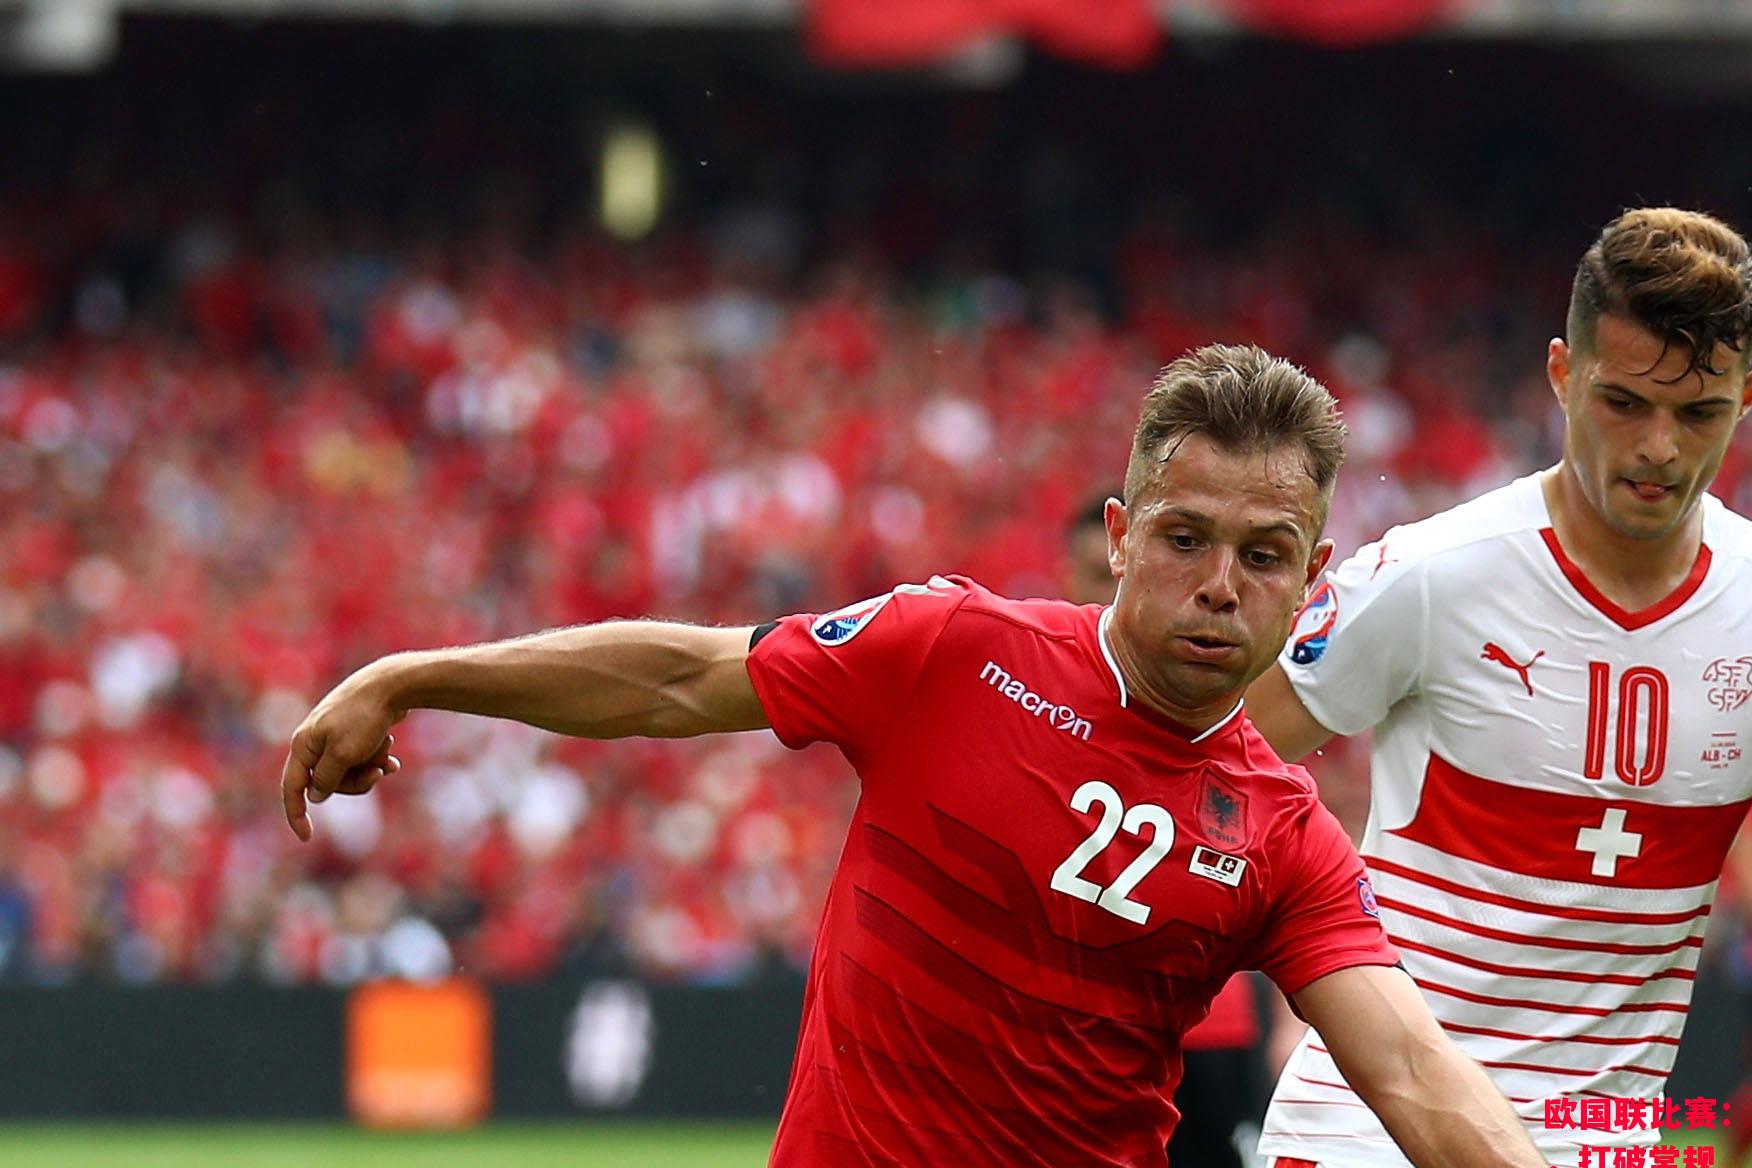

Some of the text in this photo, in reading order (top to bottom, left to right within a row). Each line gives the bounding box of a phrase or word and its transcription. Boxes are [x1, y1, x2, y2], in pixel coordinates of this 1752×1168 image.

[979, 660, 1093, 741] macron
[1584, 661, 1669, 786] 10
[1700, 750, 1720, 761] ALB
[1050, 780, 1175, 925] 22
